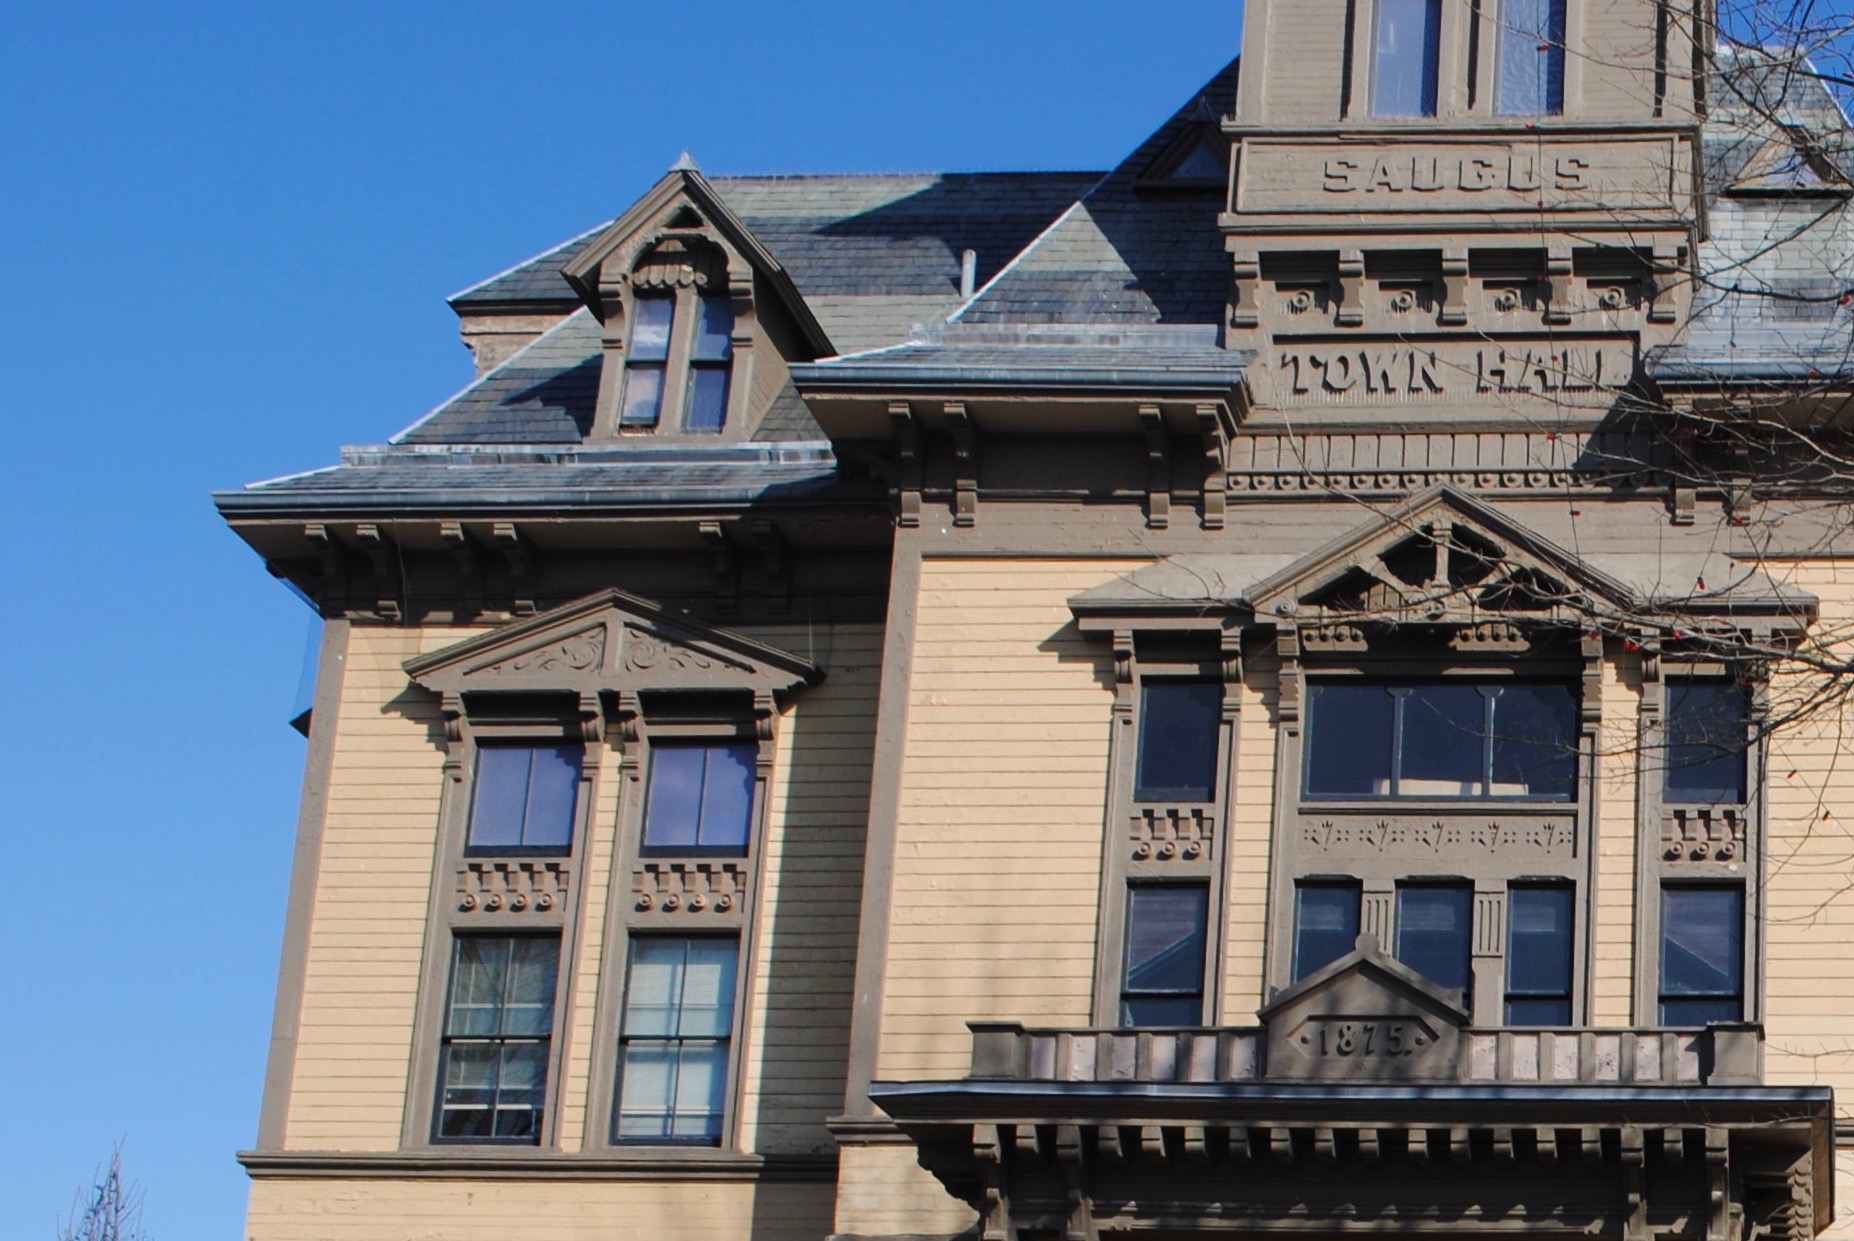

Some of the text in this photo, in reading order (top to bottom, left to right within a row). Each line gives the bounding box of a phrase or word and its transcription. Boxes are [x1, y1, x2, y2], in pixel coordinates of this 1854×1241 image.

[1322, 156, 1591, 193] SAUGUS
[1281, 350, 1636, 395] TOWN HALL
